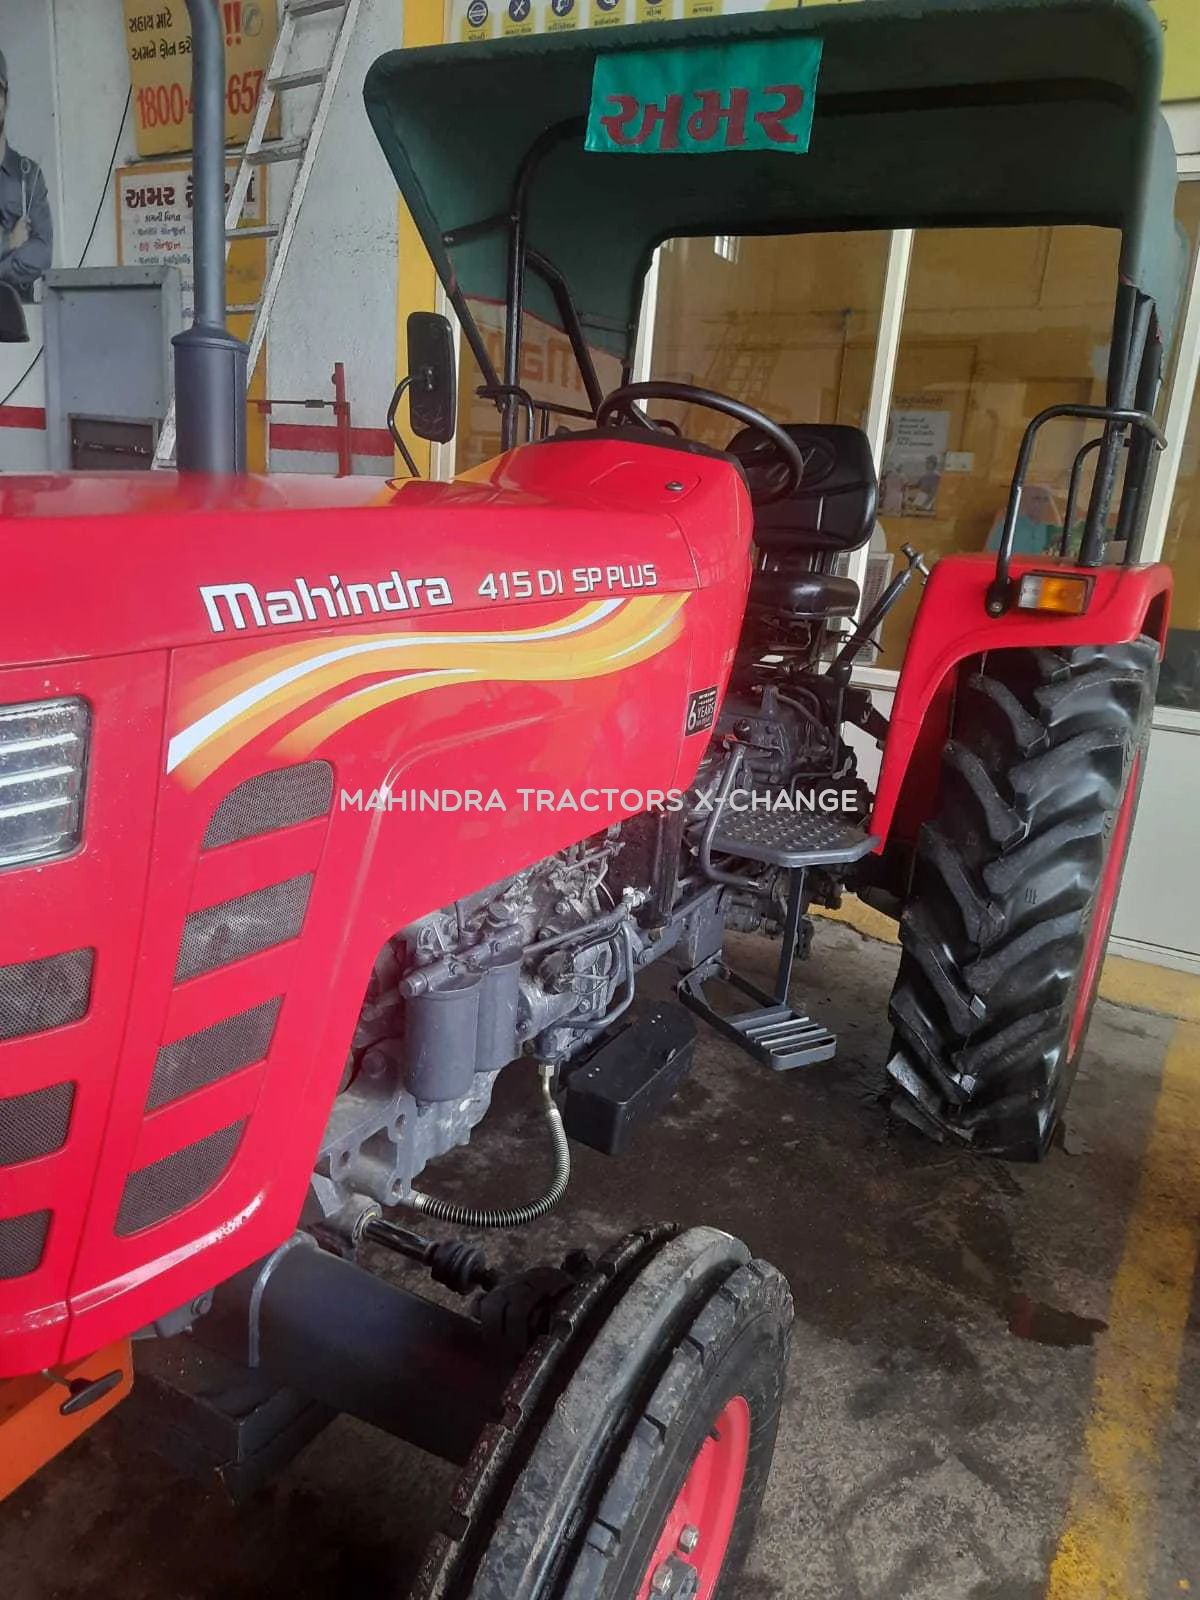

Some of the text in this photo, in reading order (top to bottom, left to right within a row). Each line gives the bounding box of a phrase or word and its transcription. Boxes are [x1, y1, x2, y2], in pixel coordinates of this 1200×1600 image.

[156, 6, 173, 29] માટે
[601, 84, 804, 150] અમર
[125, 186, 175, 209] અમર
[199, 564, 658, 632] Mahindra 415 DI SP PLUS
